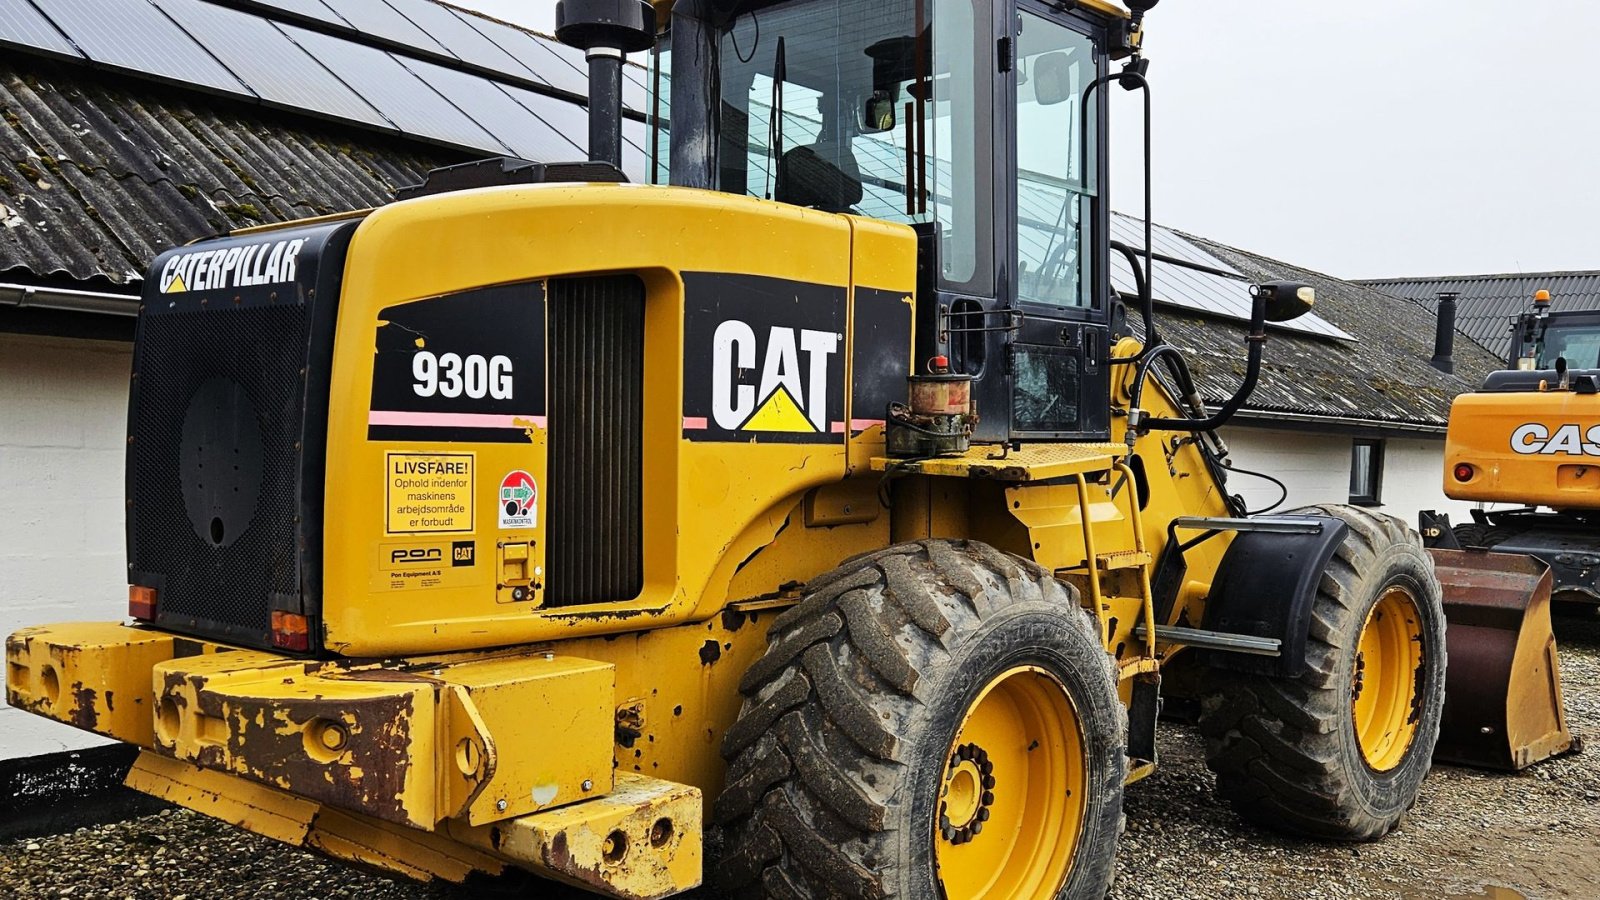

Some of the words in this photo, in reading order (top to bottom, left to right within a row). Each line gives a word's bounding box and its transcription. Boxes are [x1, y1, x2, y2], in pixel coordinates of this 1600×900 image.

[160, 238, 304, 293] CATERPILLAR
[412, 350, 513, 400] 930G
[712, 320, 838, 432] CAT
[395, 461, 468, 474] LIVSFARE!
[394, 479, 429, 489] Ophold
[431, 478, 467, 488] indenfor
[407, 492, 456, 501] maskinens
[396, 504, 465, 516] arbejdsområde
[409, 519, 419, 527] er
[421, 517, 453, 527] forbudt
[454, 547, 473, 560] CAT
